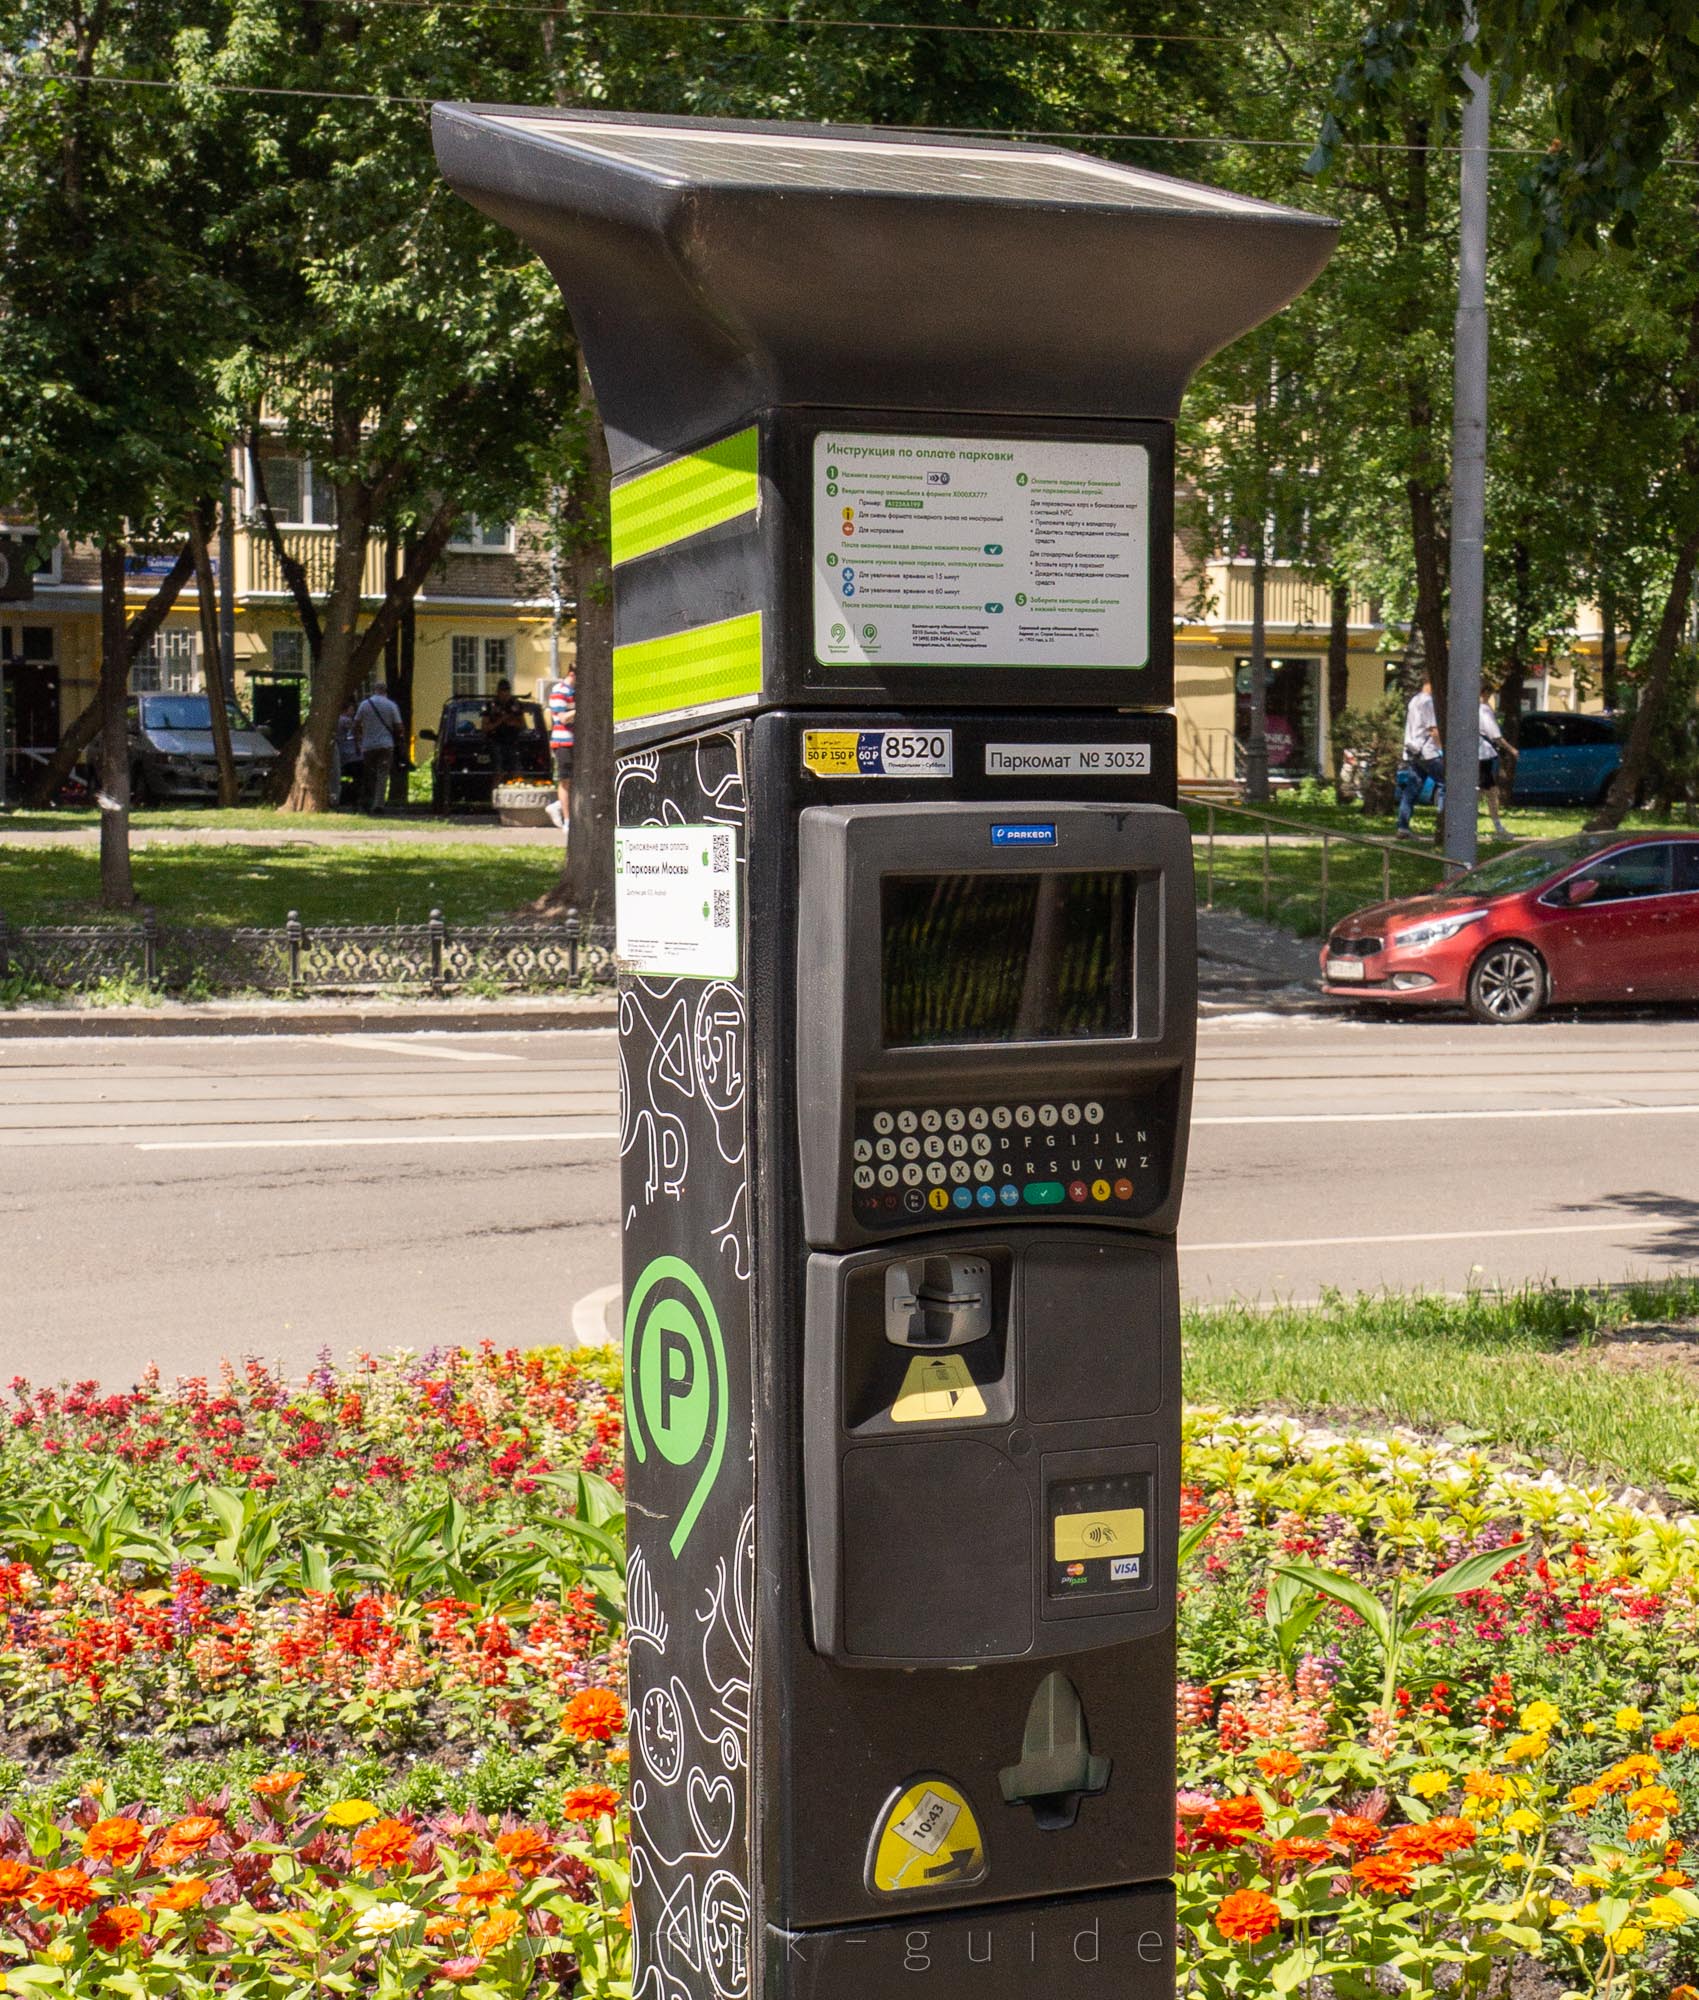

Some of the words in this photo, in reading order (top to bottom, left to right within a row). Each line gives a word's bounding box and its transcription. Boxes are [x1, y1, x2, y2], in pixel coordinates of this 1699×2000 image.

[827, 443, 896, 459] Инструкция
[899, 448, 913, 457] по
[916, 450, 956, 459] оплате
[959, 451, 1014, 462] парковки
[808, 751, 819, 760] 50
[830, 751, 846, 760] 150
[859, 751, 871, 760] 60
[885, 736, 946, 759] 8520
[991, 752, 1071, 771] Паркомат
[1080, 752, 1099, 771] №
[1104, 752, 1145, 768] 3032
[1008, 831, 1052, 839] PARKEON
[626, 861, 660, 879] Парковки
[662, 861, 689, 875] Москвы
[880, 1117, 888, 1129] 0
[904, 1116, 911, 1127] 1
[928, 1115, 935, 1126] 2
[952, 1114, 959, 1125] 3
[975, 1113, 982, 1124] 4
[998, 1112, 1005, 1123] 5
[1022, 1111, 1029, 1122] 6
[1045, 1110, 1052, 1121] 7
[1068, 1109, 1075, 1120] 8
[1090, 1108, 1097, 1119] 9
[858, 1145, 867, 1156] A
[882, 1144, 890, 1155] B
[905, 1142, 914, 1153] C
[930, 1141, 938, 1152] E
[953, 1140, 962, 1151] H
[977, 1139, 986, 1150] K
[1001, 1138, 1009, 1149] D
[1024, 1136, 1032, 1147] F
[1046, 1135, 1055, 1146] G
[1072, 1134, 1076, 1146] I
[1094, 1134, 1099, 1144] J
[1115, 1132, 1123, 1144] L
[1137, 1131, 1146, 1142] N
[859, 1171, 870, 1183] M
[909, 1169, 917, 1180] P
[932, 1168, 940, 1178] T
[955, 1166, 964, 1177] X
[1002, 1164, 1012, 1176] Q
[1027, 1163, 1035, 1174] R
[1050, 1161, 1057, 1173] S
[1072, 1160, 1080, 1171] U
[1095, 1159, 1103, 1170] V
[1115, 1158, 1127, 1169] W
[1140, 1157, 1148, 1168] Z
[660, 1328, 694, 1431] P
[1114, 1562, 1138, 1574] VISA
[912, 1804, 944, 1839] 10:43
